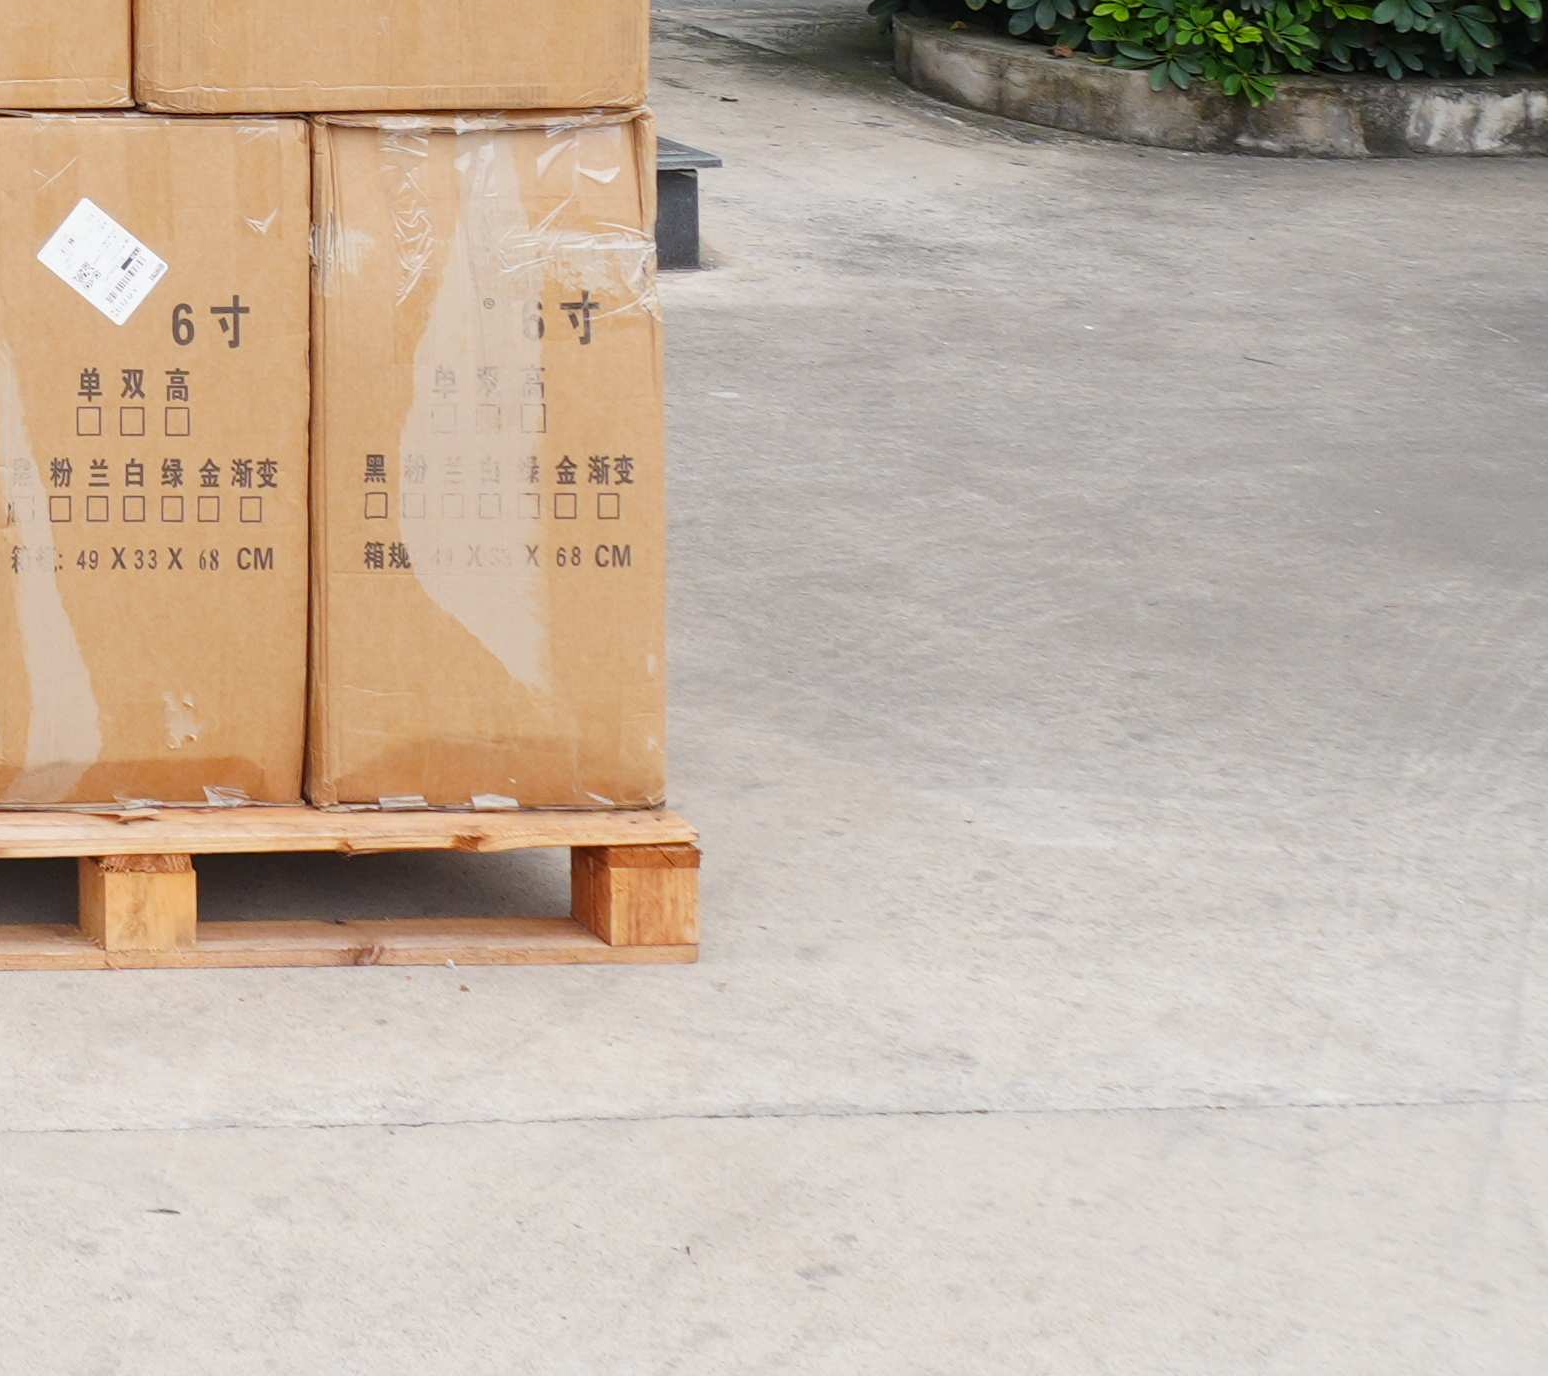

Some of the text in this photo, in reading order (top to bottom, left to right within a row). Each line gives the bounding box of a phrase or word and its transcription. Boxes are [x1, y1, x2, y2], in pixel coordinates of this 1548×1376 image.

[171, 294, 250, 349] 6寸
[236, 547, 274, 571] CM
[556, 544, 632, 568] 68 CM
